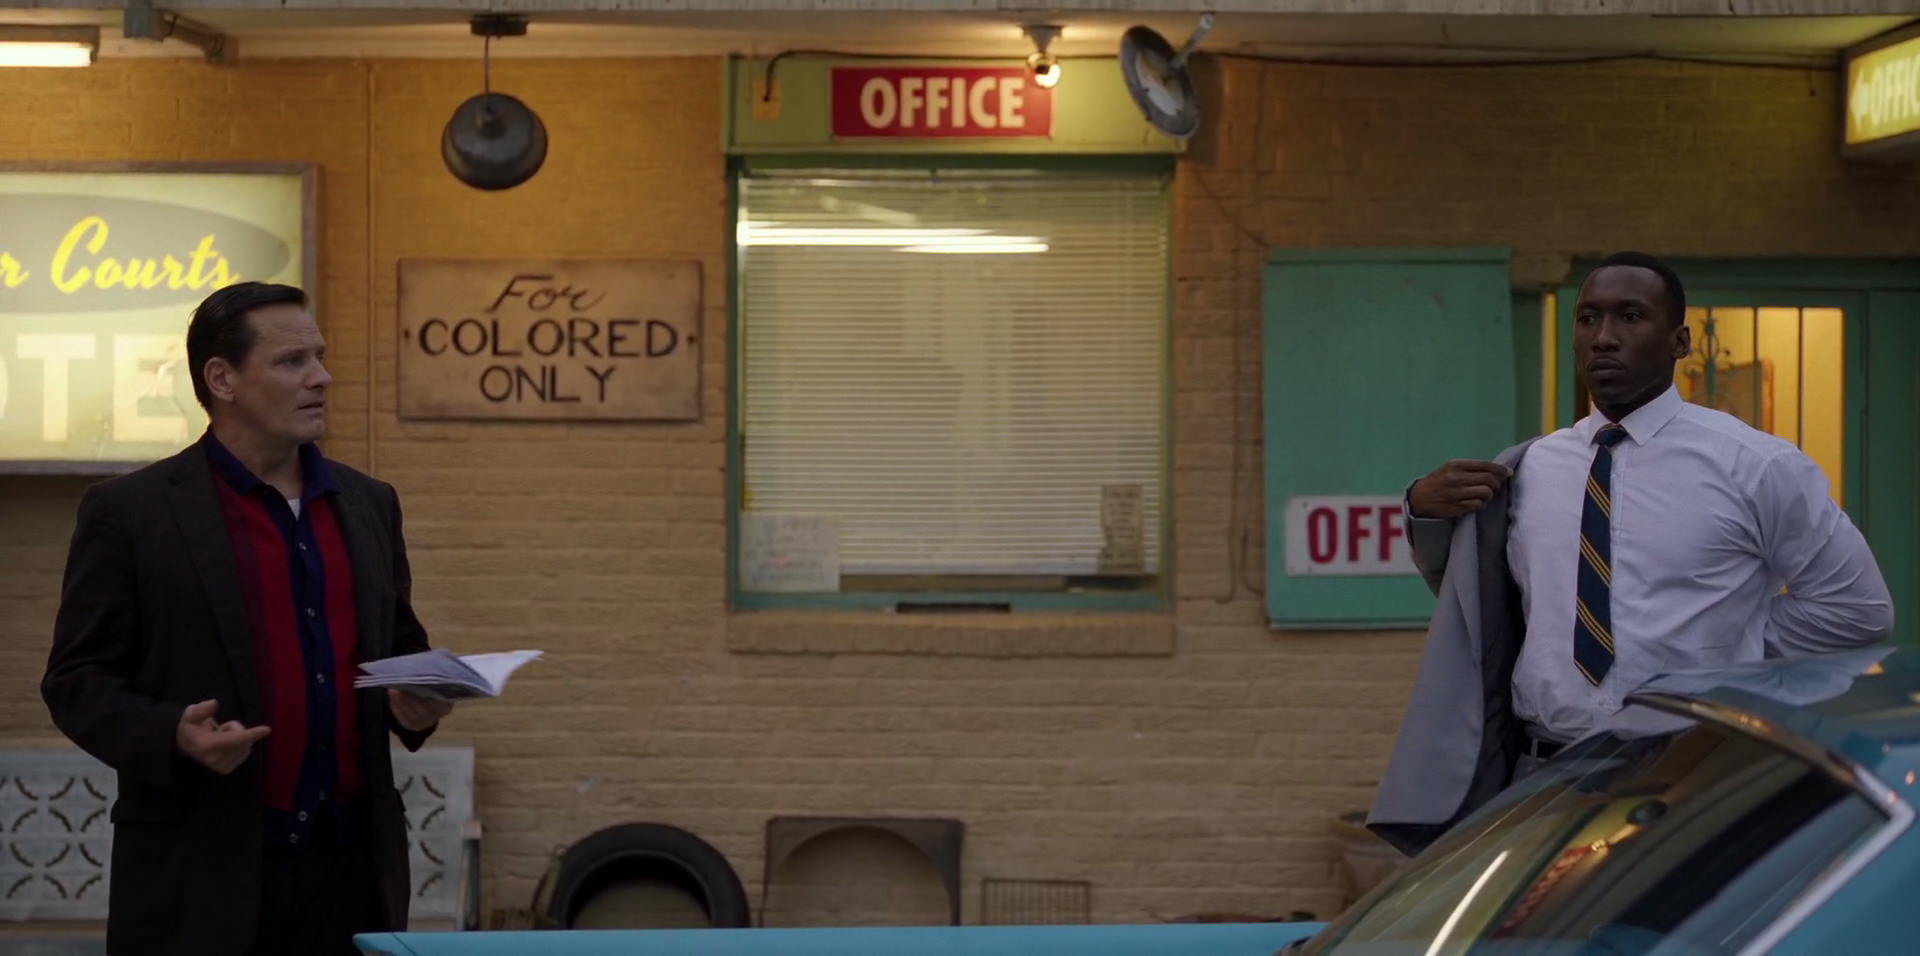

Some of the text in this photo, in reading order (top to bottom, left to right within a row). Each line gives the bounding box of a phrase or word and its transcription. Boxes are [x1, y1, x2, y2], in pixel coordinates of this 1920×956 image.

[860, 76, 1026, 129] OFFICE
[50, 215, 241, 294] Courts
[485, 273, 607, 314] For
[418, 317, 679, 358] COLORED
[0, 333, 188, 443] TE
[479, 365, 617, 403] ONLY
[1307, 505, 1404, 564] OFF
